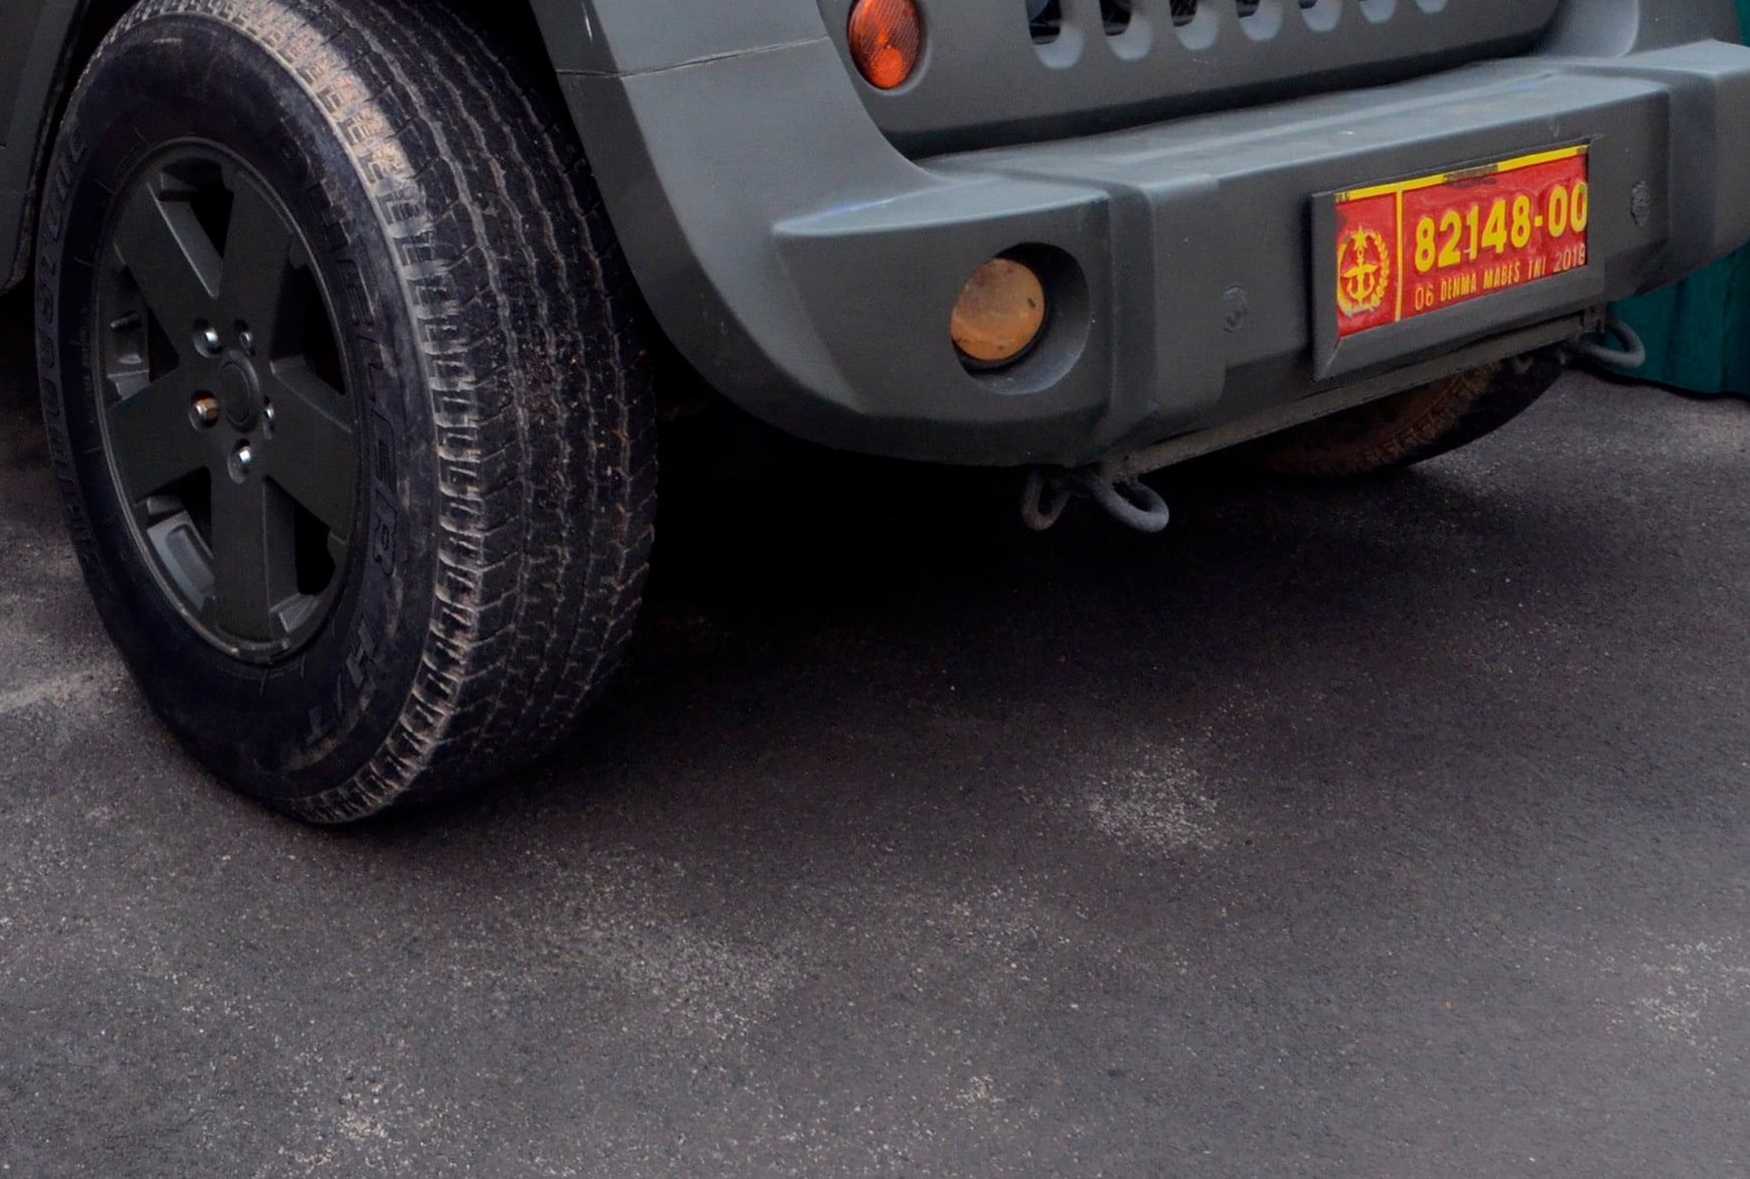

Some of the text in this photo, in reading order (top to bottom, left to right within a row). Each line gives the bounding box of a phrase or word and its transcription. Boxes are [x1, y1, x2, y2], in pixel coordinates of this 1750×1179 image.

[1414, 183, 1588, 273] 82148-00
[1415, 283, 1434, 311] 06
[1440, 274, 1477, 302] DENMA
[1484, 261, 1520, 289] MABES
